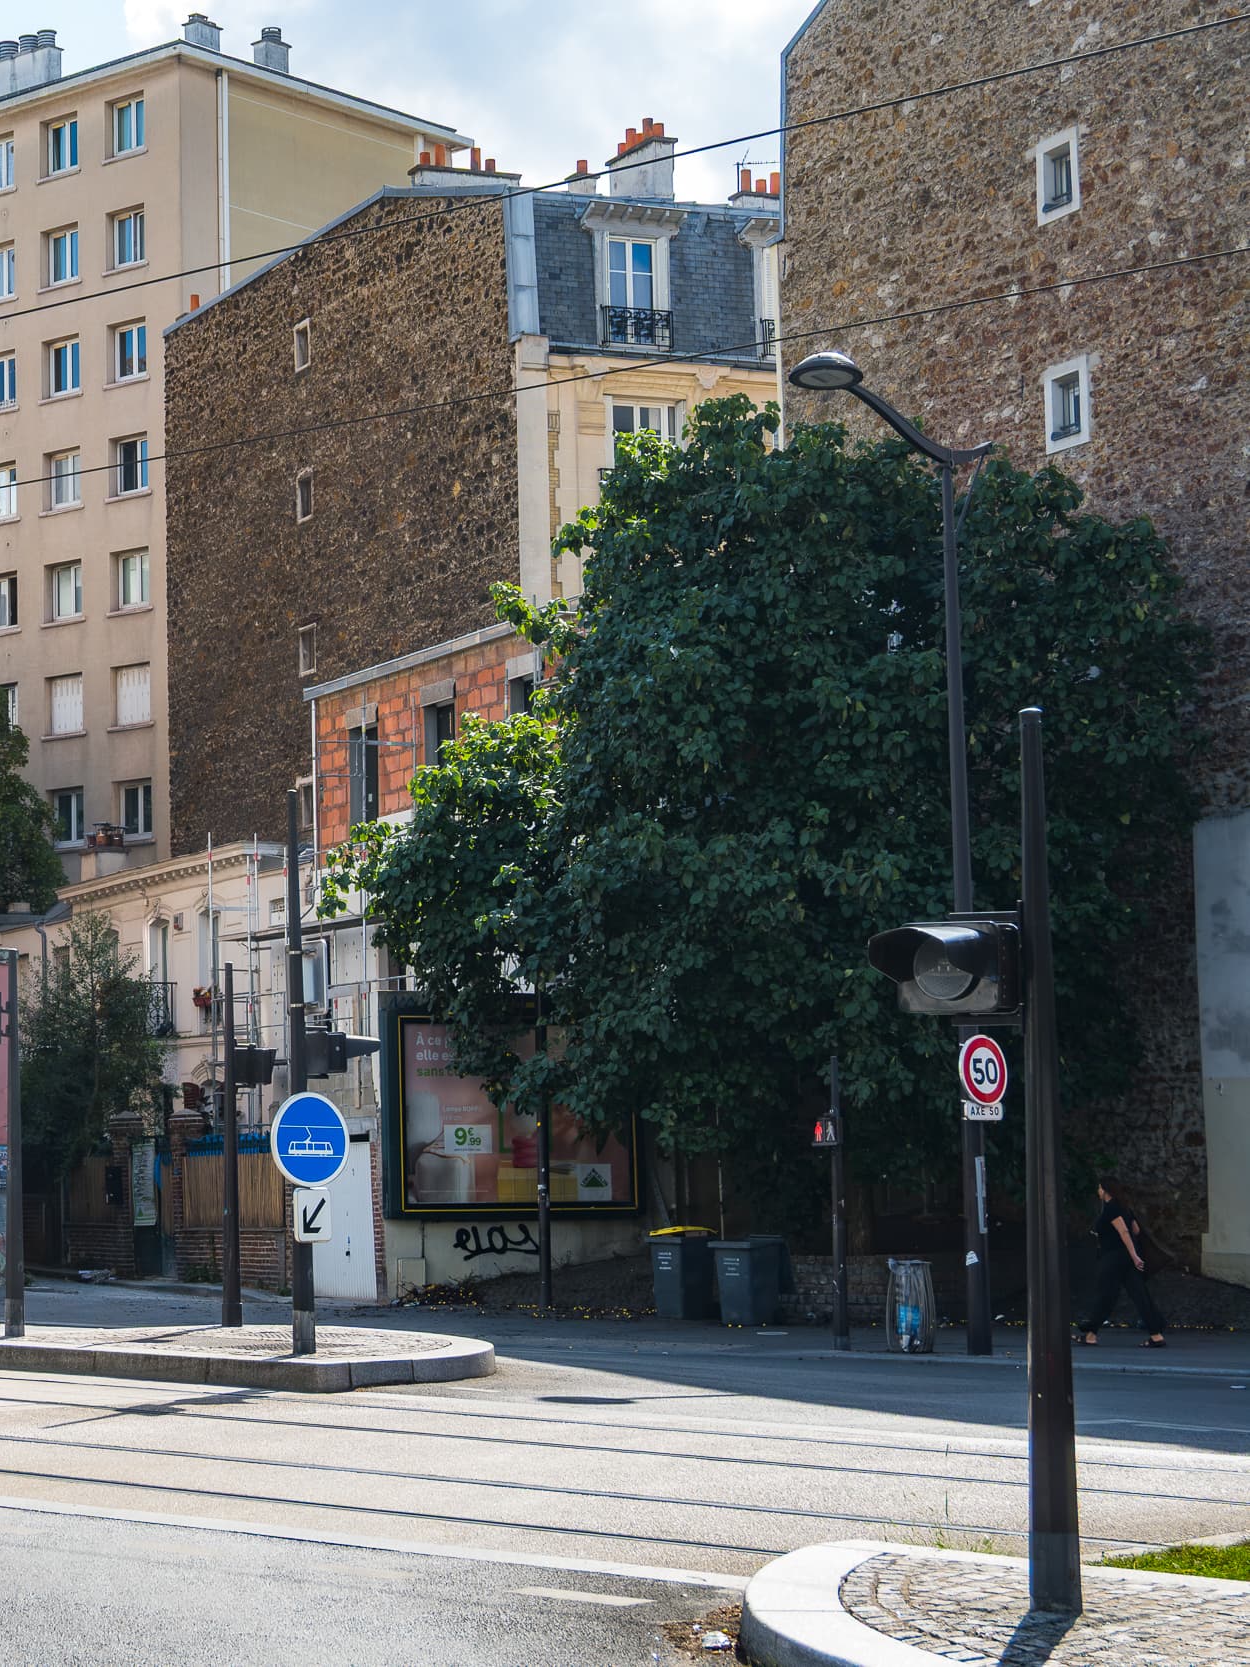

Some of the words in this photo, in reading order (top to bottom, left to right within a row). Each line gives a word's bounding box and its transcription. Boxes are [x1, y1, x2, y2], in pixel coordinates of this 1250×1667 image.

[427, 1035, 441, 1046] ce
[415, 1049, 439, 1061] elle
[416, 1067, 445, 1077] sans
[972, 1057, 999, 1085] 50
[970, 1106, 986, 1116] AXE
[989, 1106, 1000, 1116] 50
